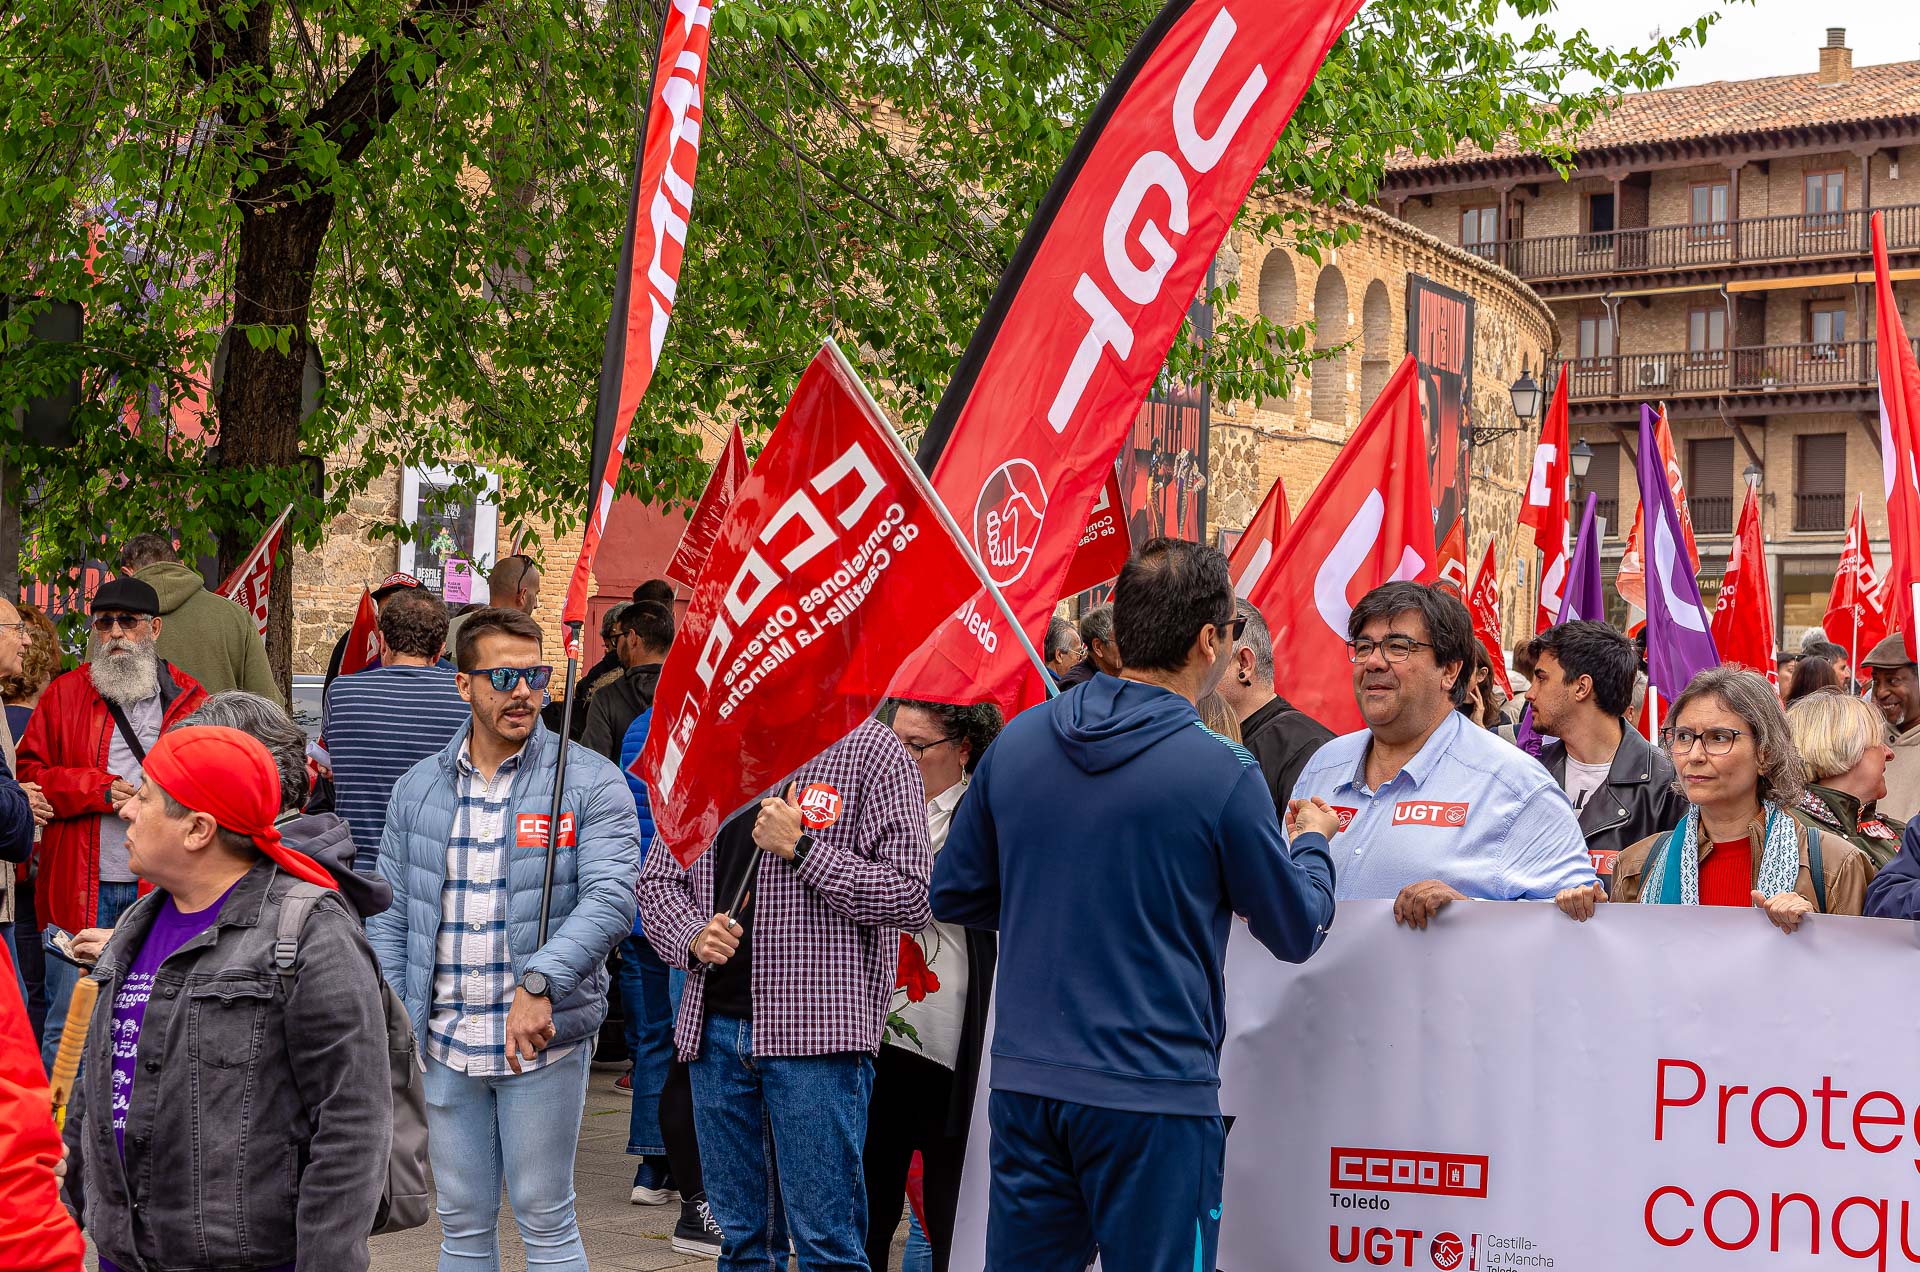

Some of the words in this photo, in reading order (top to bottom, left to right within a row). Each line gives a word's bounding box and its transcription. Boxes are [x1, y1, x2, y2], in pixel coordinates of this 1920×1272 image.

[1047, 6, 1268, 434] UGT
[416, 567, 442, 580] DESFILE
[955, 599, 998, 654] ledo
[802, 788, 838, 813] UGT
[1394, 804, 1443, 822] UGT
[520, 817, 573, 834] CCO
[1654, 1058, 1920, 1174] Prote
[1338, 1155, 1440, 1187] CCOO
[1329, 1193, 1391, 1212] Toledo
[1329, 1225, 1423, 1268] UGT
[1487, 1234, 1537, 1250] Castilla-
[1487, 1250, 1501, 1264] La
[1504, 1252, 1554, 1268] Mancha
